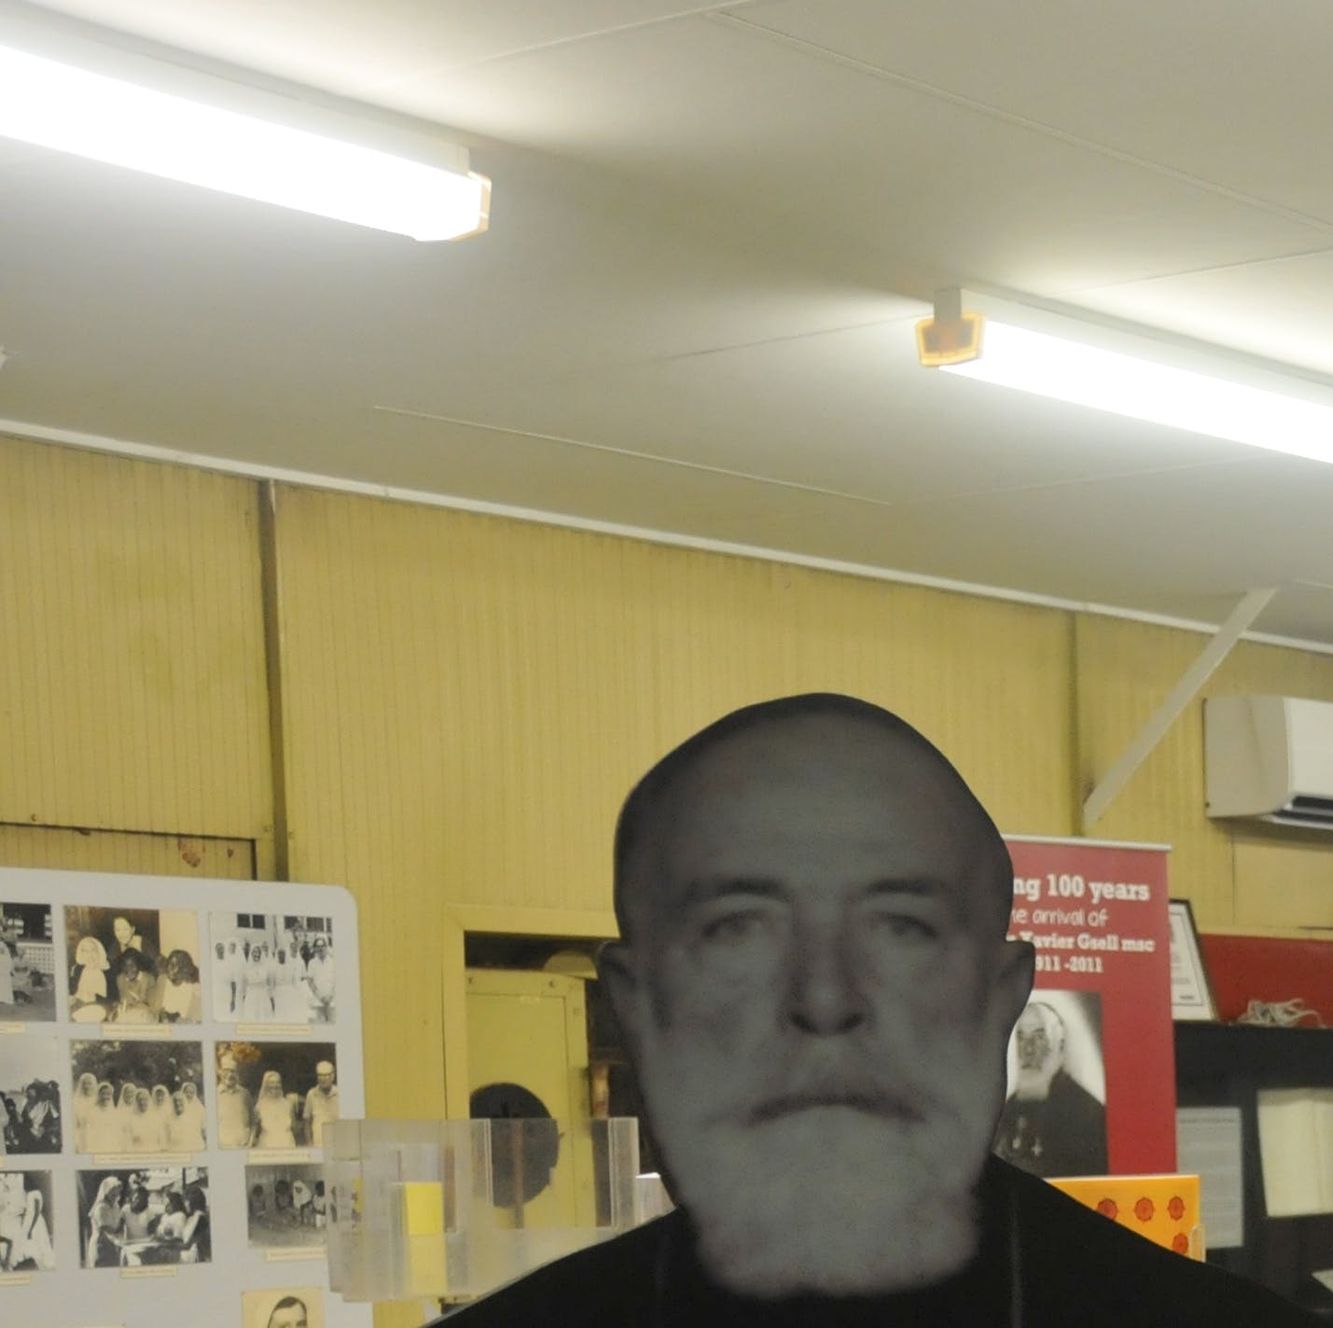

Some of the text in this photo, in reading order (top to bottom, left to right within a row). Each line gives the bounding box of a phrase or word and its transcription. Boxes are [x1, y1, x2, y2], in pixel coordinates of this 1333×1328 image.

[1047, 874, 1085, 898] 100
[1088, 881, 1150, 904] years
[1032, 909, 1086, 926] arrival
[1087, 908, 1110, 927] of
[1077, 932, 1120, 951] Gsell
[1121, 939, 1156, 953] msc
[1035, 955, 1061, 972] 911
